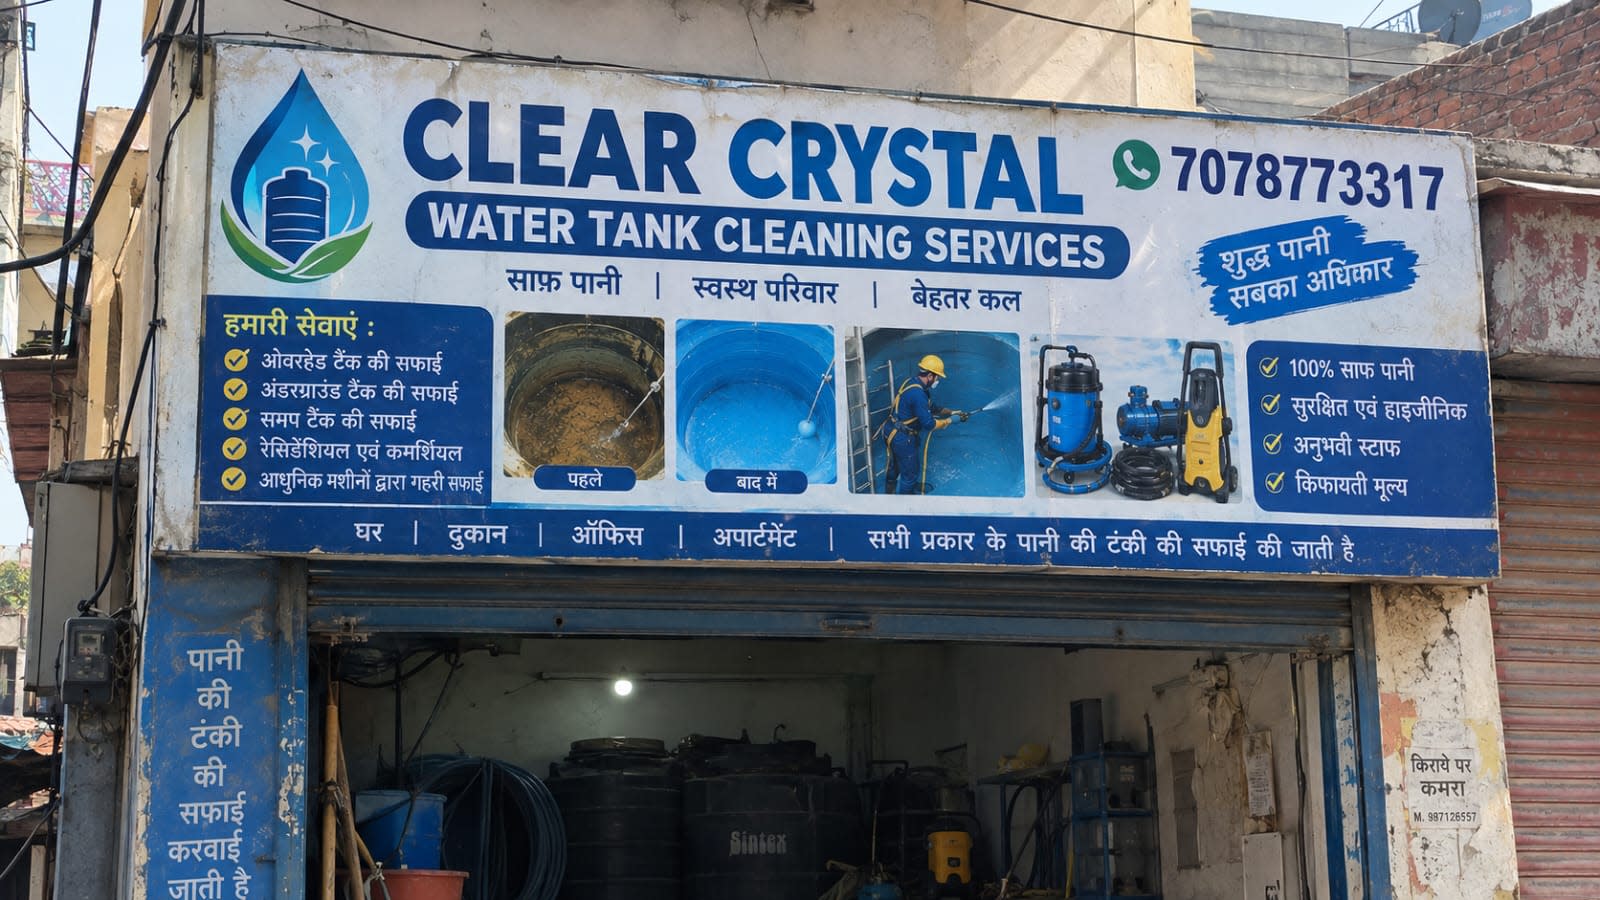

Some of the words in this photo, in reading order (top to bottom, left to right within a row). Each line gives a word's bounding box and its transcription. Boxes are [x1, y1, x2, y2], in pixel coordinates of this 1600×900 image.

[403, 98, 701, 194] CLEAR
[728, 118, 1083, 215] CRYSTAL
[1171, 146, 1444, 211] 7078773317
[428, 202, 575, 245] WATER
[588, 210, 701, 251] TANK
[714, 216, 912, 260] CLEANING
[925, 227, 1105, 269] SERVICES
[1219, 244, 1271, 280] शुद्ध
[1277, 226, 1331, 260] पानी
[570, 265, 623, 295] पानी
[692, 277, 758, 301] स्वस्थ
[764, 273, 839, 304] परिवार
[911, 278, 971, 311] बेहतर
[978, 290, 1022, 312] कल
[1228, 275, 1298, 309] सबका
[1306, 257, 1394, 292] अधिकार
[223, 308, 288, 338] हमारी
[296, 308, 358, 340] सेवाएं
[261, 348, 327, 372] ओवरहेड
[333, 349, 361, 371] टैंक
[368, 350, 390, 372] की
[395, 351, 443, 375] सफाई
[1289, 359, 1334, 378] 100%
[1339, 361, 1374, 379] साफ
[1380, 357, 1415, 382] पानी
[261, 378, 342, 399] अंडरग्राउंड
[348, 378, 376, 400] टैंक
[383, 380, 405, 401] की
[411, 381, 459, 405] सफाई
[260, 411, 300, 429] समप
[306, 406, 335, 429] टैंक
[341, 408, 363, 430] की
[370, 409, 417, 432] सफाई
[1291, 392, 1348, 422] सुरक्षित
[1354, 395, 1377, 420] एवं
[1383, 396, 1468, 422] हाइजीनिक
[260, 436, 350, 459] रेसिडेंशियल
[356, 439, 380, 462] एवं
[386, 439, 463, 462] कमर्शियल
[1294, 432, 1352, 462] अनुभवी
[1357, 438, 1401, 457] स्टाफ
[259, 467, 323, 495] आधुनिक
[327, 468, 371, 490] मशीनों
[375, 472, 406, 492] द्वारा
[411, 470, 443, 492] गहरी
[447, 470, 484, 494] सफाई
[568, 467, 602, 489] पहले
[736, 475, 761, 490] बाद
[766, 471, 778, 490] में
[1295, 469, 1368, 496] किफायती
[1372, 478, 1408, 502] मूल्य
[354, 522, 384, 542] घर
[448, 524, 508, 551] दुकान
[571, 519, 644, 546] ऑफिस
[713, 522, 798, 548] अपार्टमेंट
[868, 525, 910, 550] सभी
[920, 529, 975, 552] प्रकार
[985, 526, 1006, 552] के
[1017, 527, 1060, 553] पानी
[1070, 528, 1096, 554] की
[1106, 529, 1146, 555] टंकी
[1156, 530, 1182, 556] की
[1192, 533, 1247, 561] सफाई
[1257, 534, 1283, 558] की
[1291, 535, 1334, 560] जाती
[1341, 535, 1355, 561] है
[187, 639, 244, 672] पानी
[197, 678, 232, 710] की
[190, 716, 243, 749] टंकी
[193, 756, 227, 788] की
[1410, 753, 1450, 773] किराये
[1454, 759, 1472, 773] पर
[1420, 781, 1466, 797] कमरा
[179, 791, 246, 826] सफाई
[1414, 812, 1424, 822] M.
[168, 828, 242, 863] करवाई
[729, 831, 787, 856] Sintex
[168, 868, 224, 900] जाती
[232, 866, 251, 900] है
